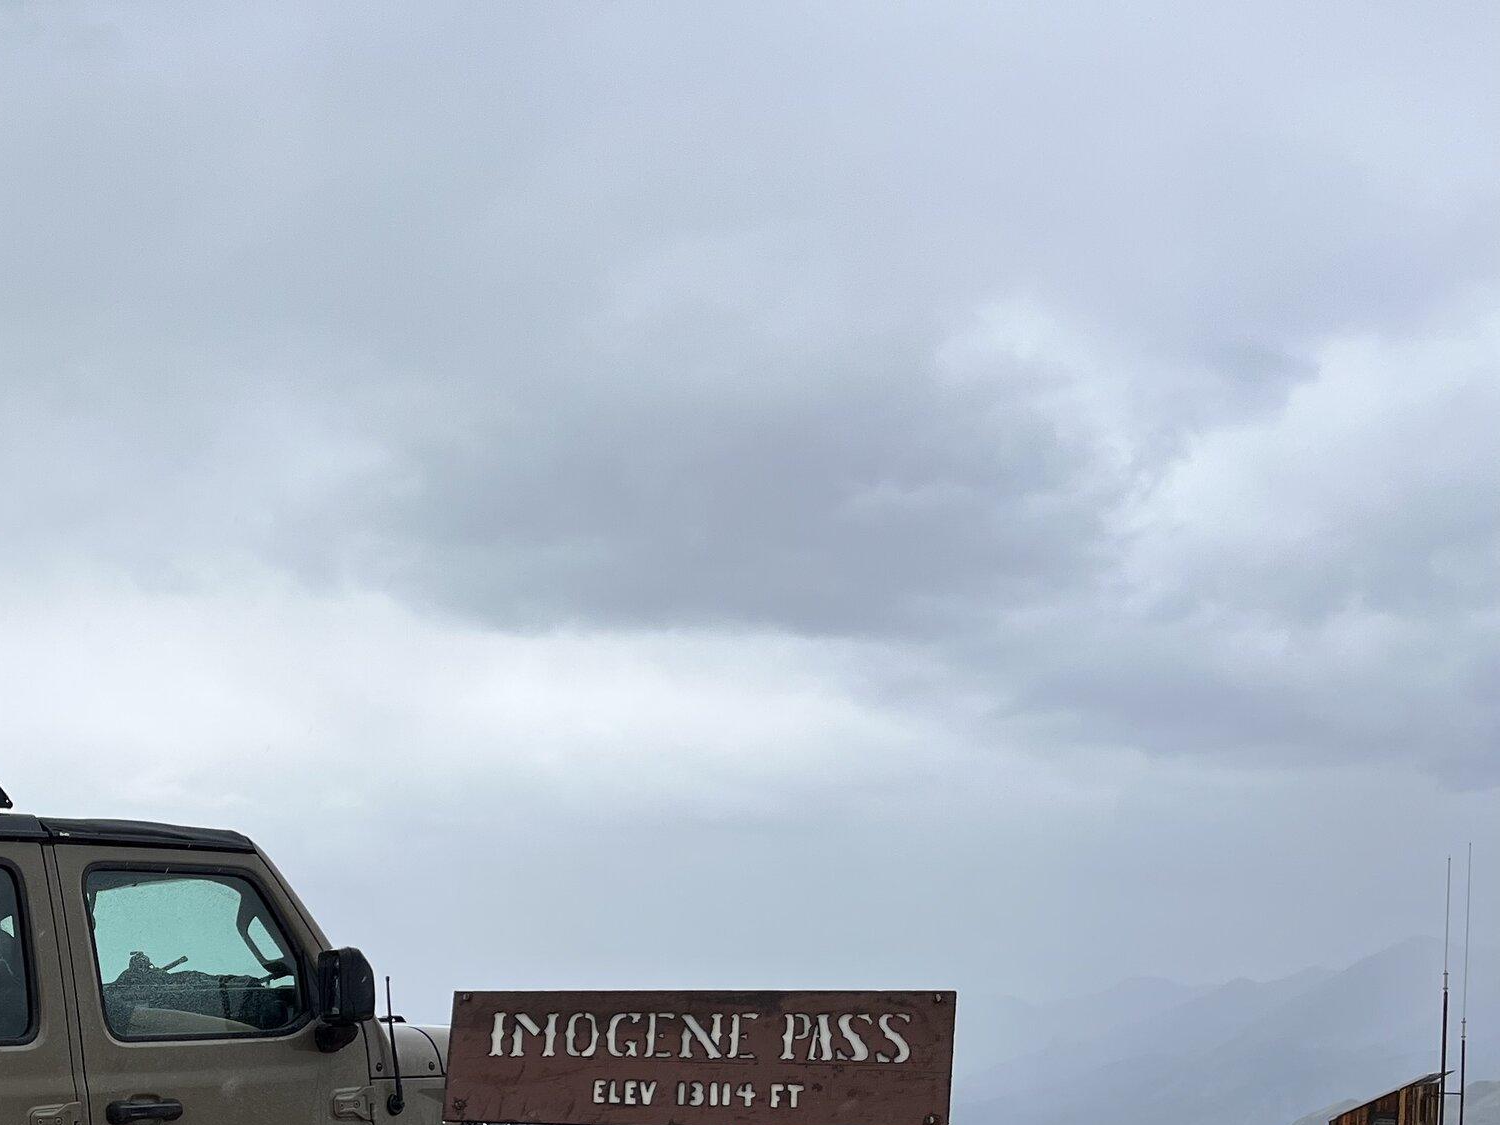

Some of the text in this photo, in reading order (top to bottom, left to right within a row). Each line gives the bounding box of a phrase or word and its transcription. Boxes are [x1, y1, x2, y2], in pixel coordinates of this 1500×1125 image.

[488, 1011, 911, 1063] IMOGENE PASS
[593, 1080, 806, 1108] ELEV 13114 FT
